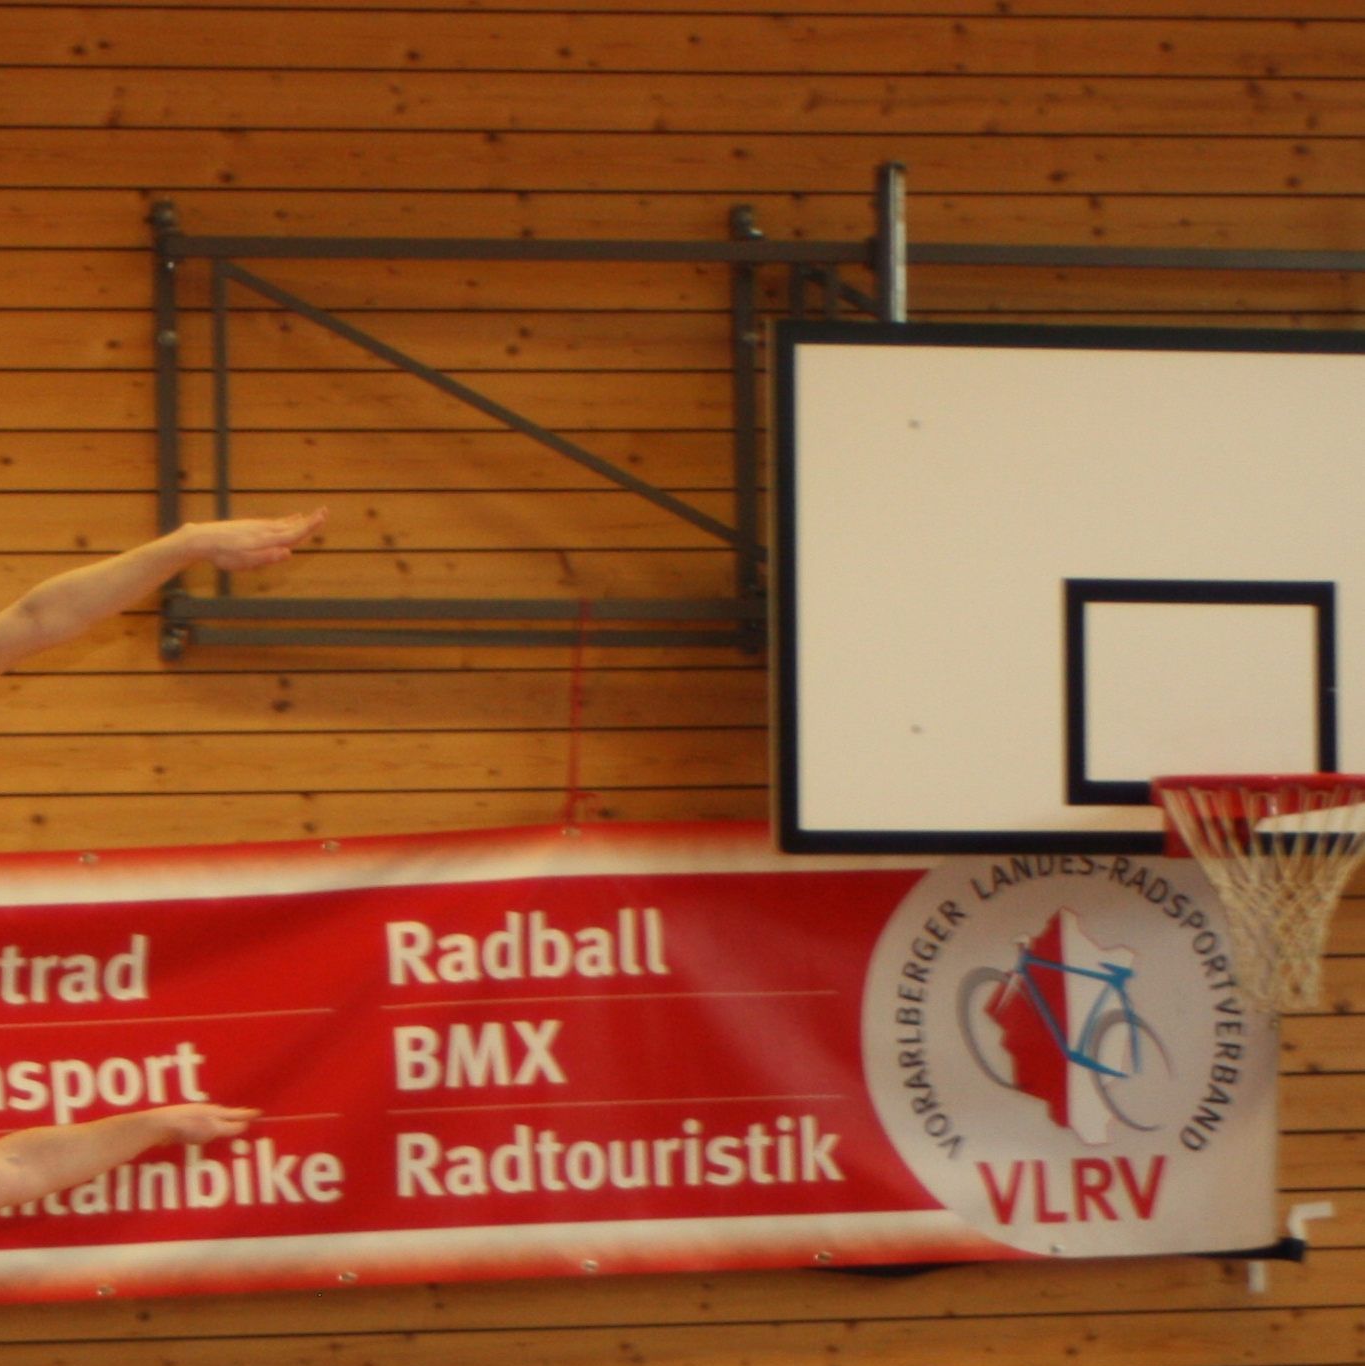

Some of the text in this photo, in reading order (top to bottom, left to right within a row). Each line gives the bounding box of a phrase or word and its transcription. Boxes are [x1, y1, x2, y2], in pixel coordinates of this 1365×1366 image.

[386, 907, 671, 985] Radball
[393, 1019, 568, 1091] BMX
[895, 899, 967, 1160] VORARLBERGER
[396, 1114, 846, 1197] Radtouristik
[975, 1154, 1168, 1226] VLRV
